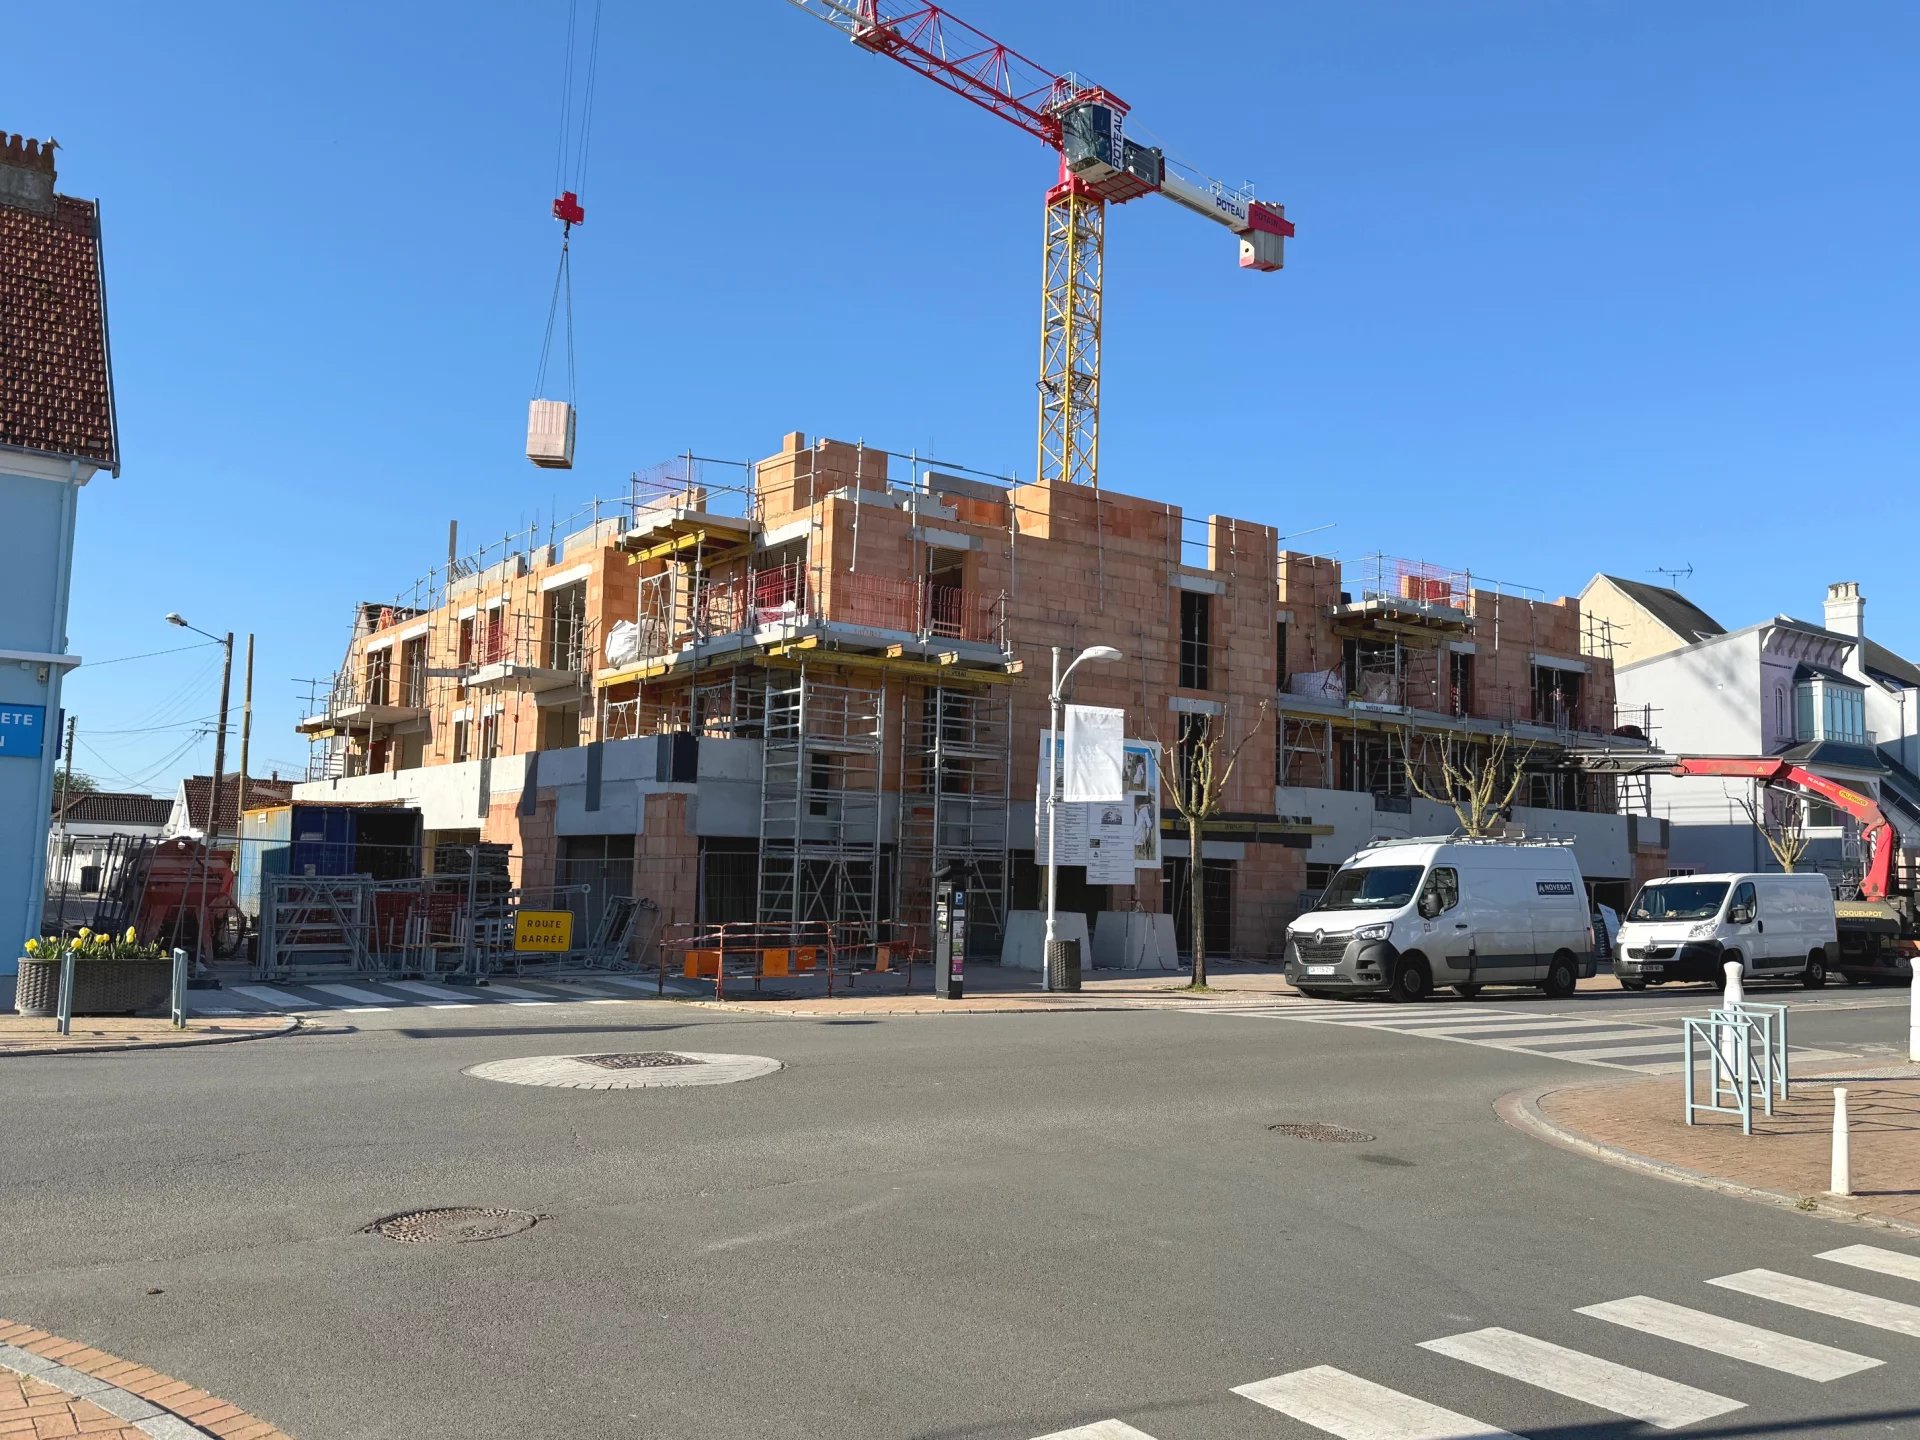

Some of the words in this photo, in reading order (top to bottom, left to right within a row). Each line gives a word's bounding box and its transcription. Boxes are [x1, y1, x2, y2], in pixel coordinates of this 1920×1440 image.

[1113, 112, 1122, 169] POTEAU
[1216, 197, 1245, 219] POTEAU
[1545, 883, 1571, 891] NOVEBAT
[955, 891, 963, 903] P
[527, 920, 561, 928] ROUTE
[521, 934, 564, 944] BARRÉE
